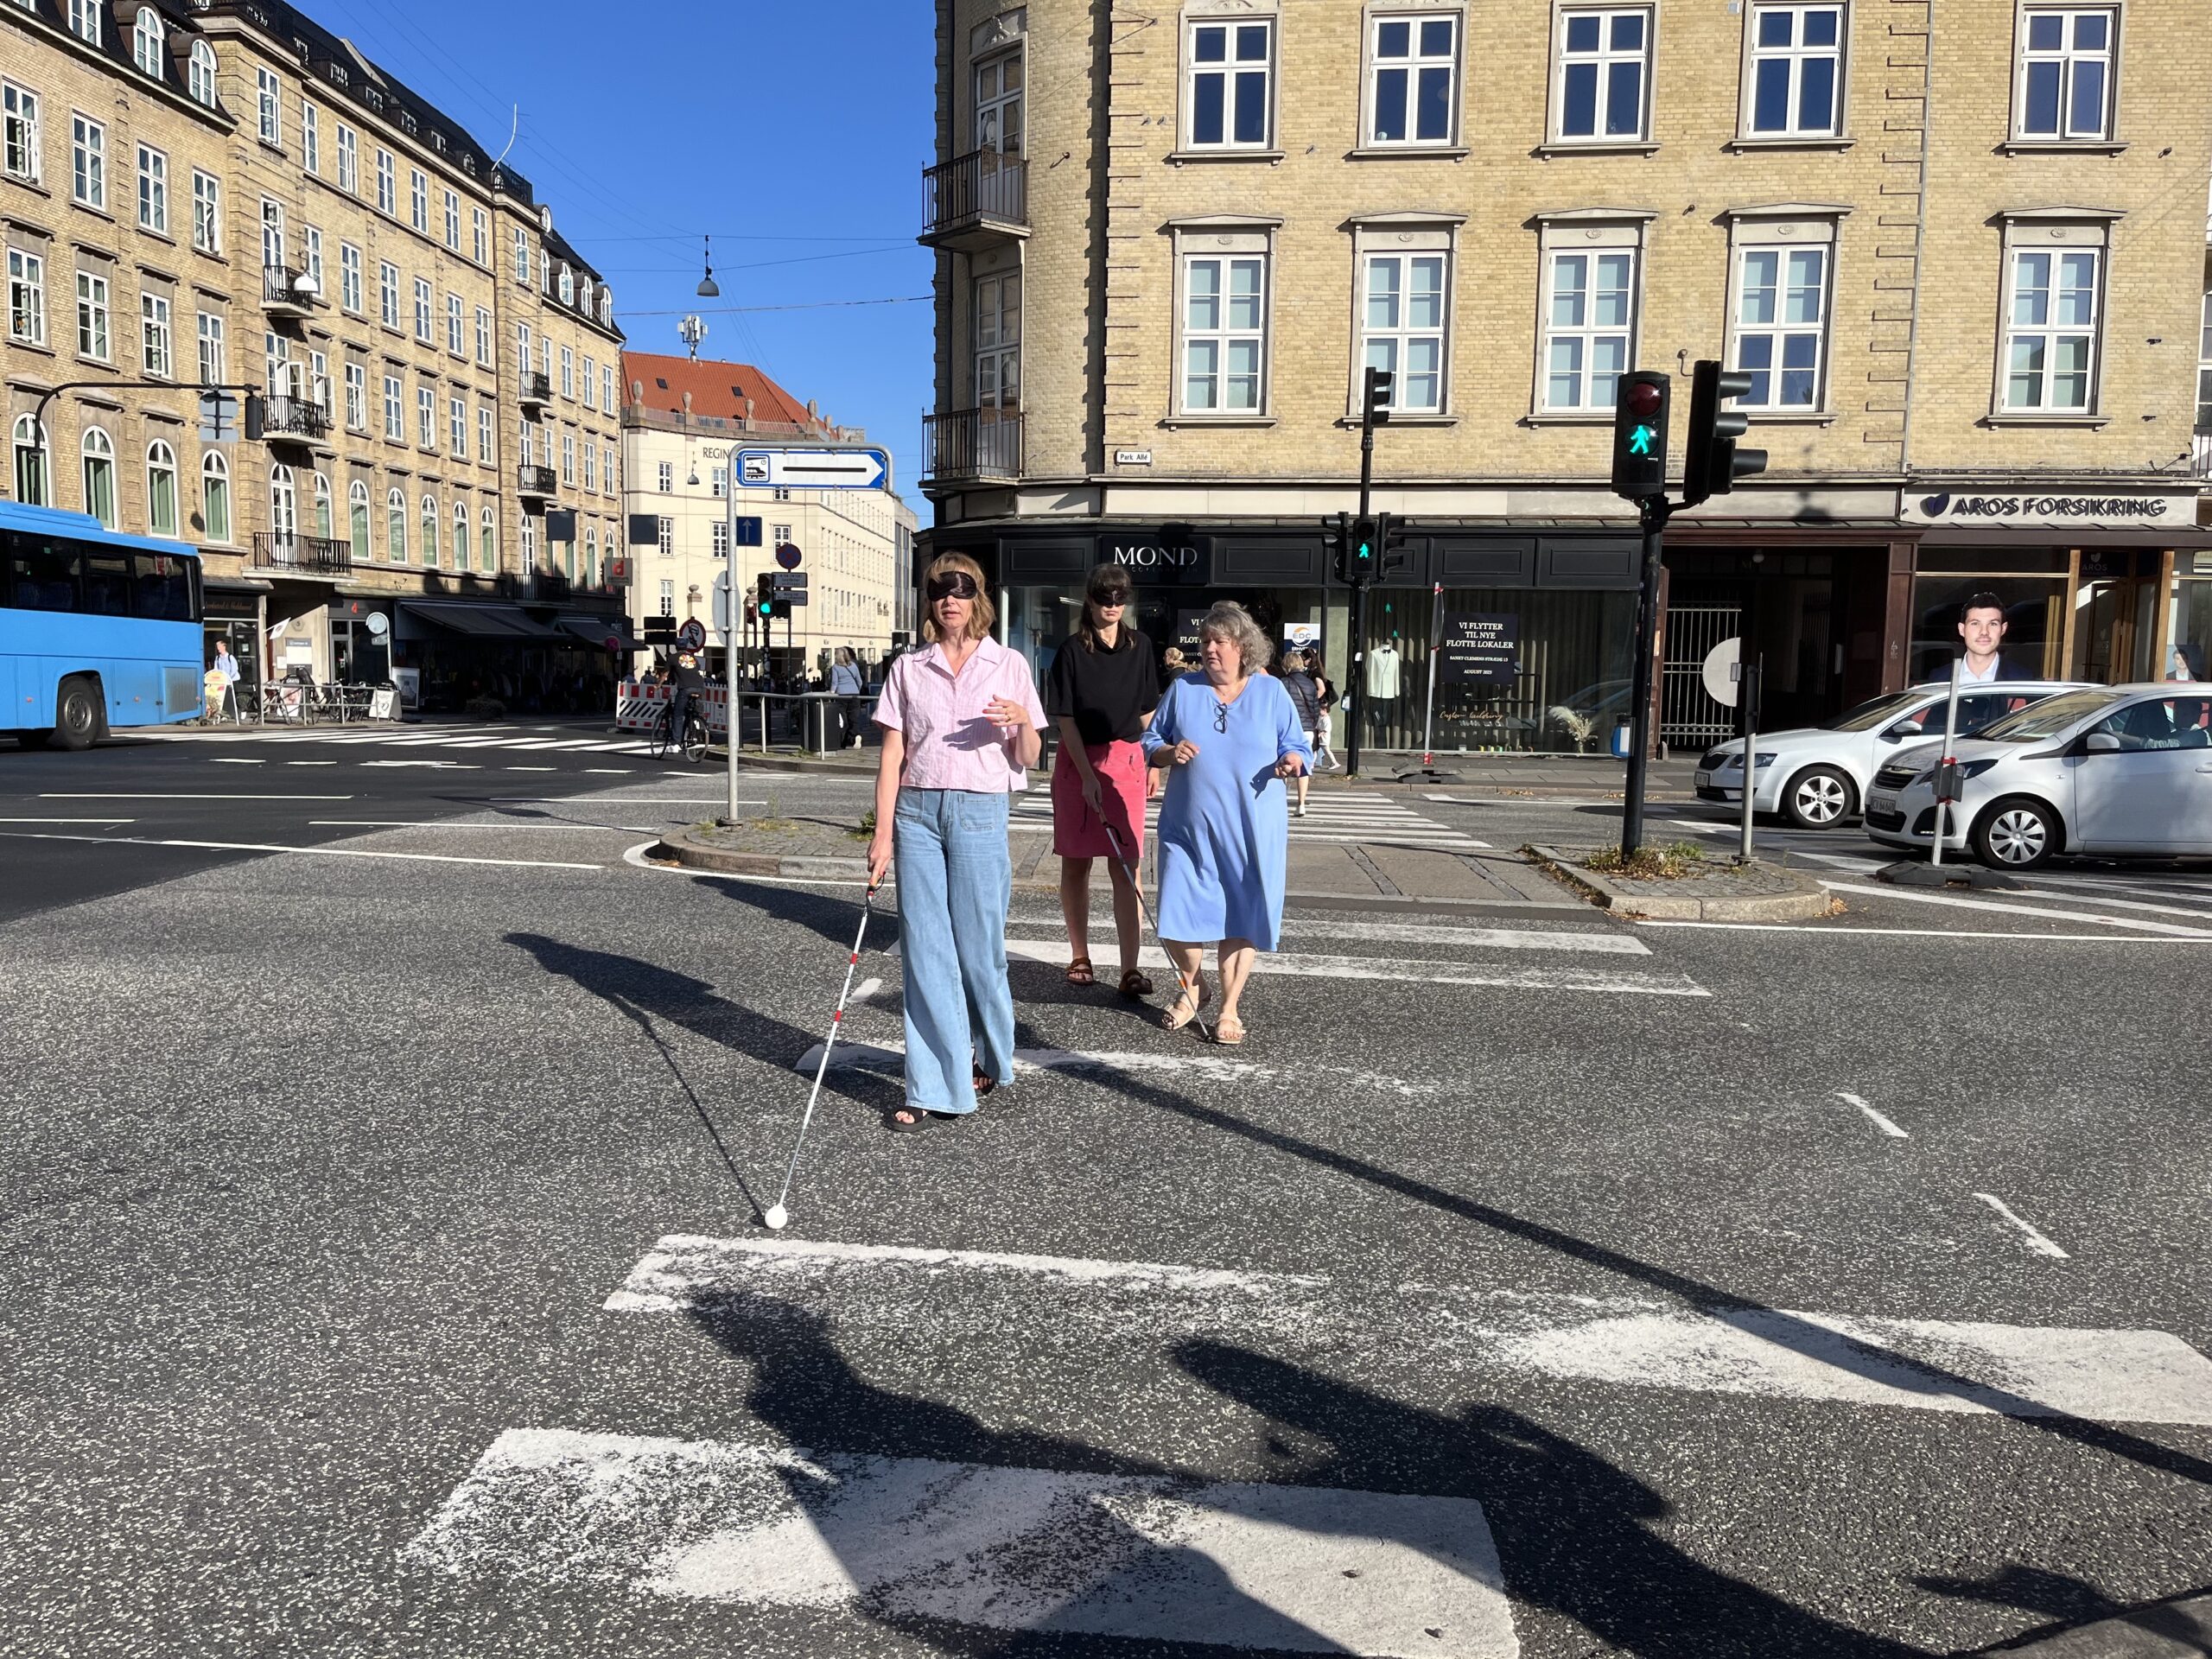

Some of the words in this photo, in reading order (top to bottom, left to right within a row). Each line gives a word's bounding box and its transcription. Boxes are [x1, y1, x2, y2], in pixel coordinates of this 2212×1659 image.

[1953, 497, 2019, 516] AROS
[2024, 498, 2167, 517] FORSIKRING
[1113, 547, 1198, 565] MOND
[2082, 563, 2107, 571] AROS
[1469, 622, 1503, 631] FLYTTER
[1478, 640, 1514, 649] LOKALER
